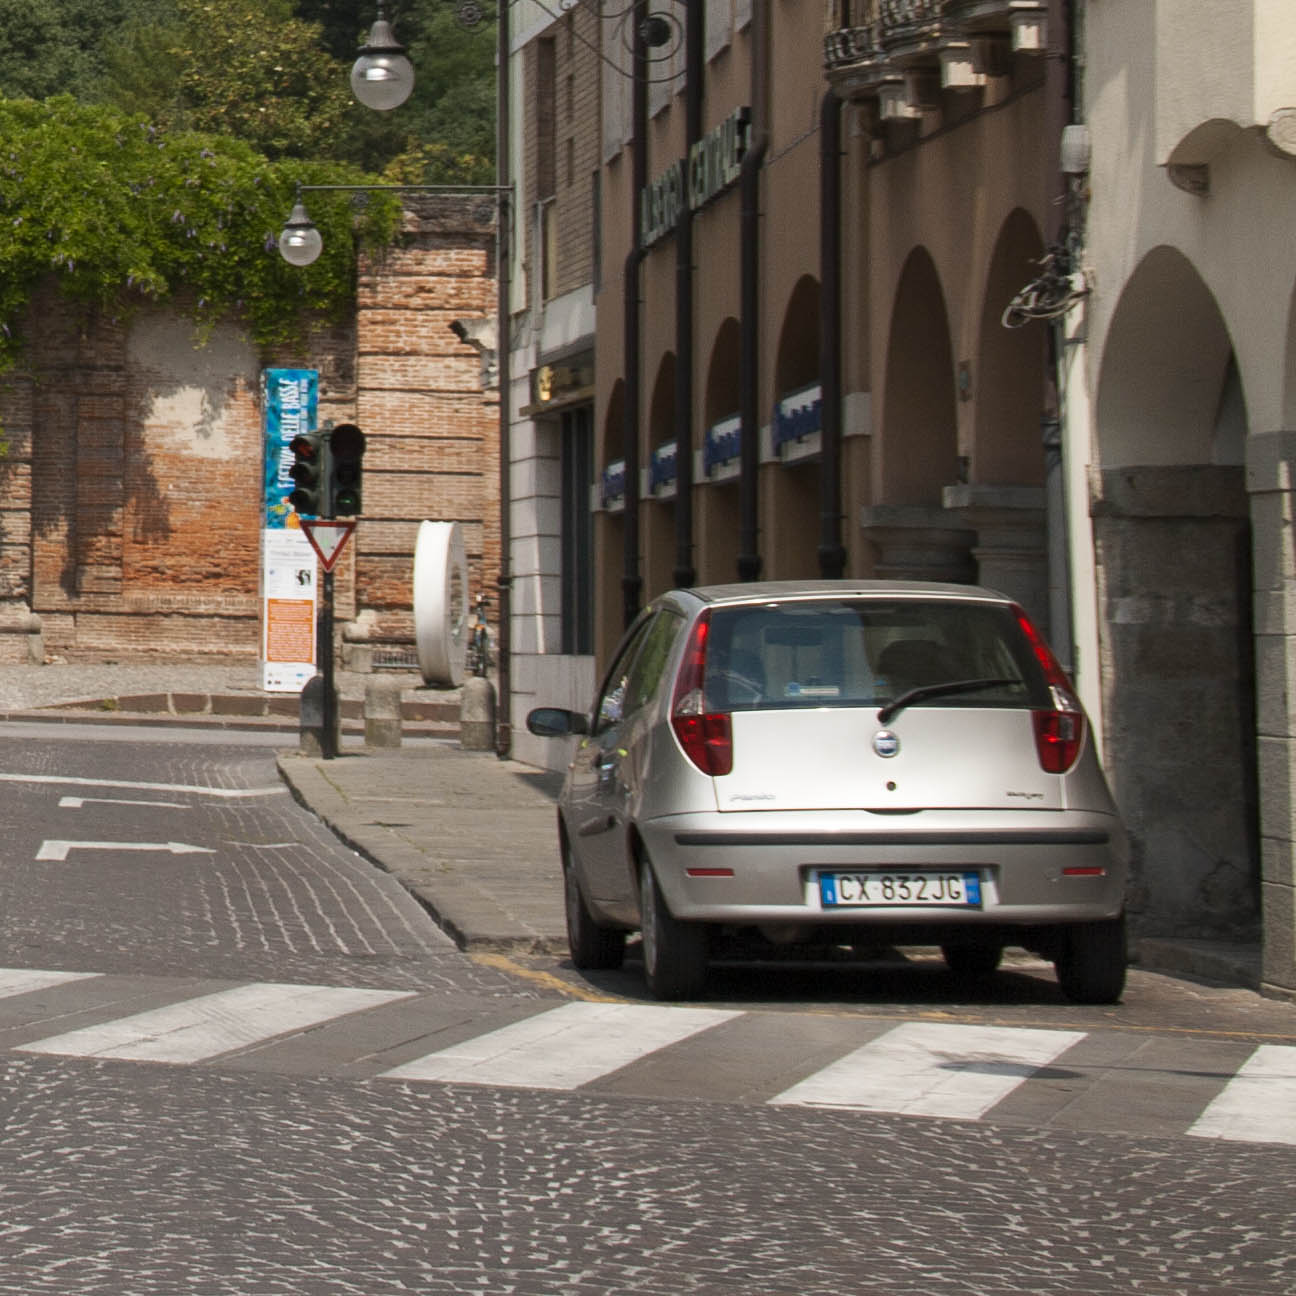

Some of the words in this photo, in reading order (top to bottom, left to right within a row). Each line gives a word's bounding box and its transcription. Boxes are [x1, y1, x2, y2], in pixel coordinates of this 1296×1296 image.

[278, 377, 301, 410] BASSE
[279, 412, 300, 442] DELLE
[839, 875, 870, 901] CX
